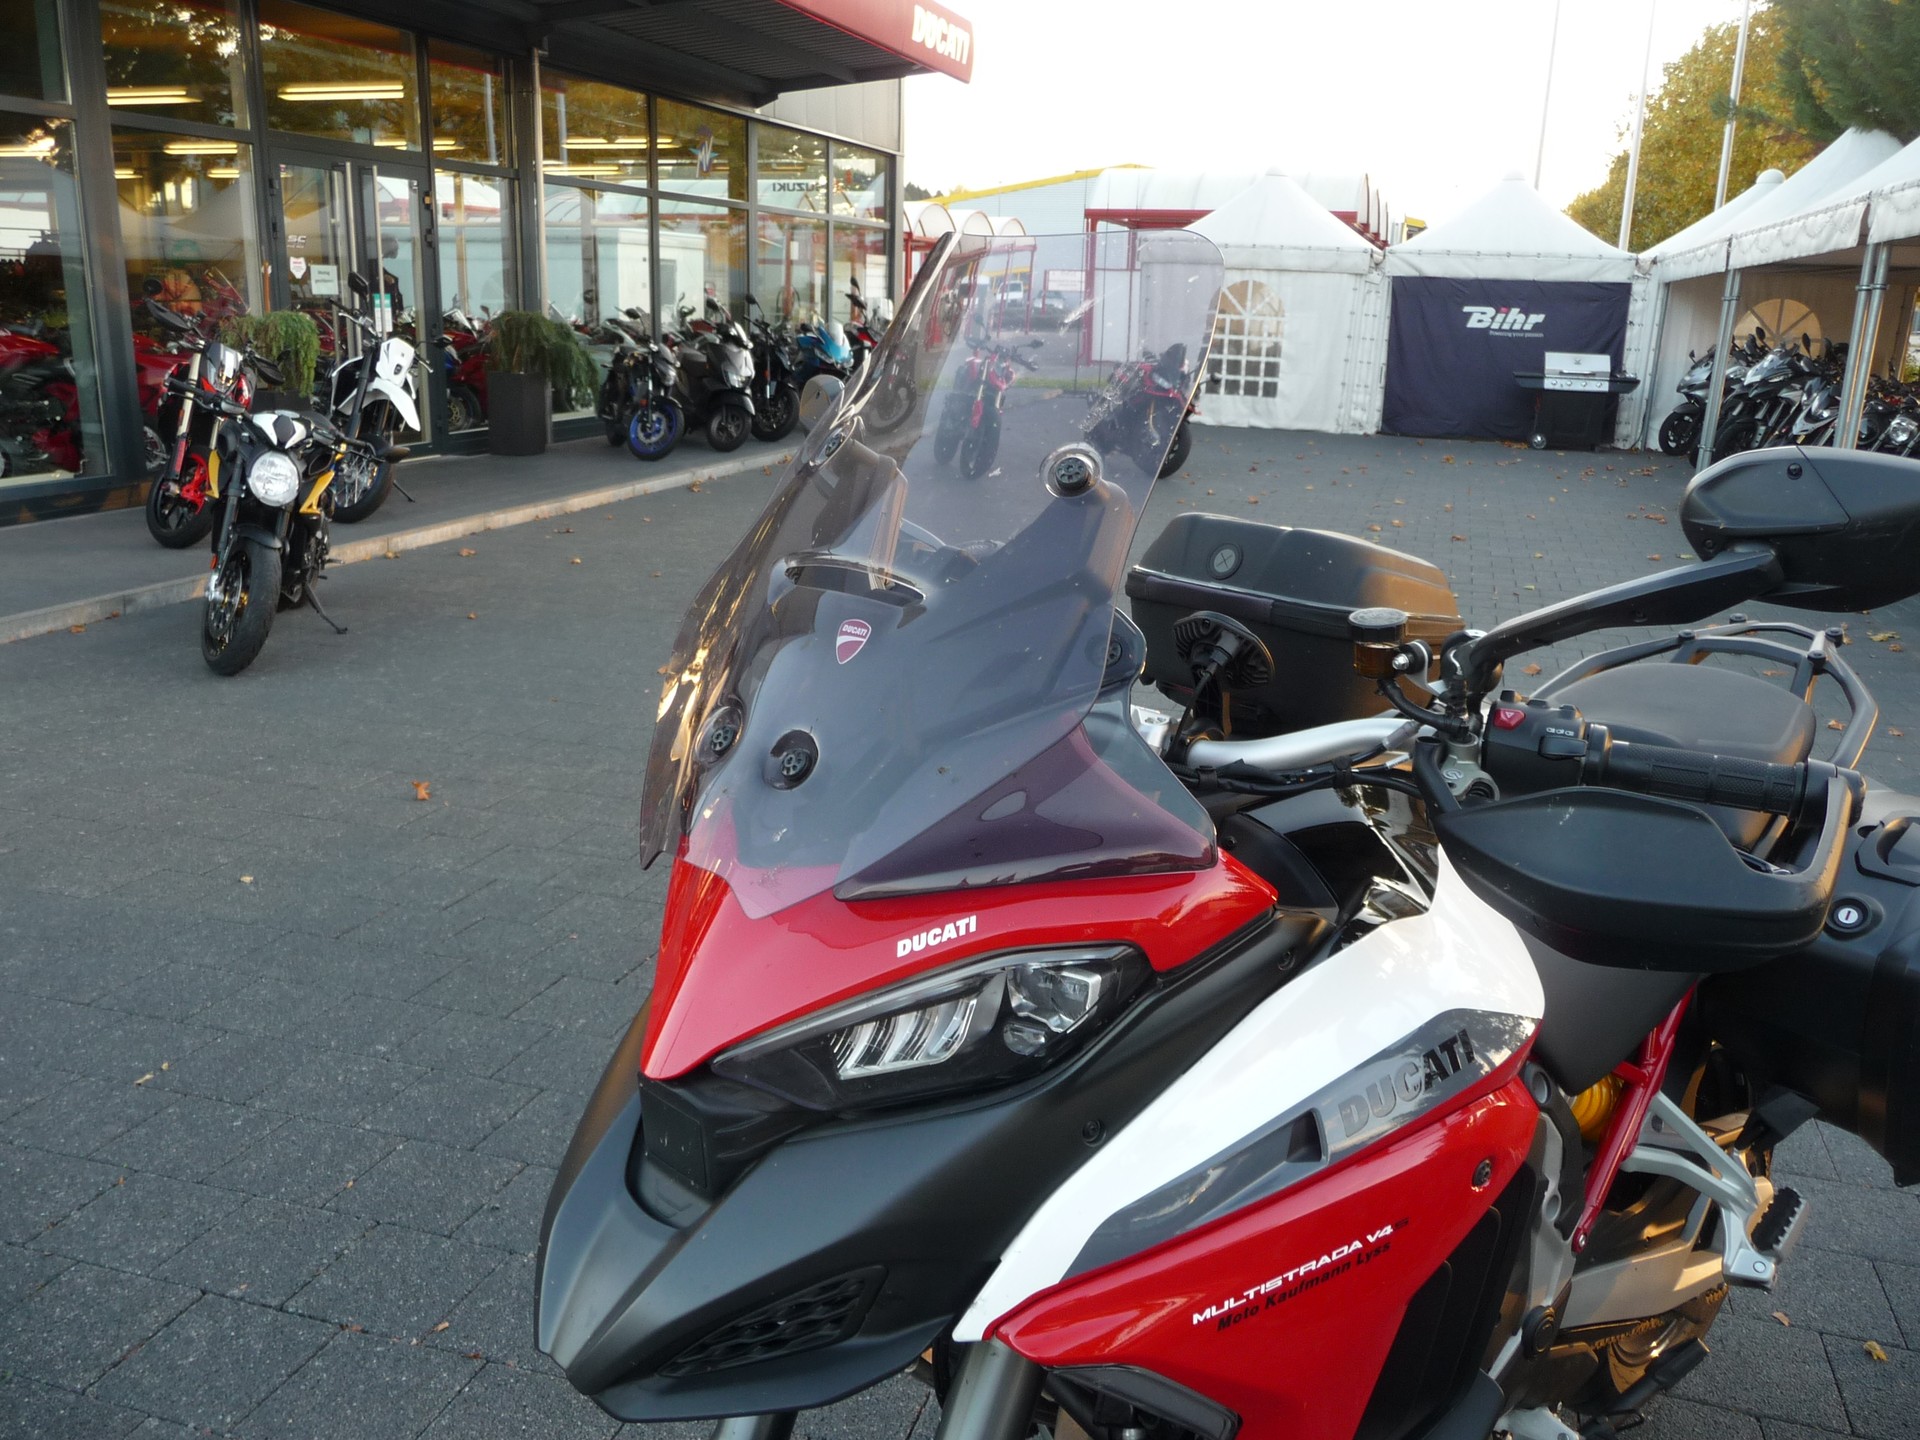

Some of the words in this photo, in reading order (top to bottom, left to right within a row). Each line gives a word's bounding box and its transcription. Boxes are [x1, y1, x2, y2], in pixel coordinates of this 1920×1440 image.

[912, 4, 970, 65] DUCATI
[1462, 306, 1546, 331] Bihr
[842, 624, 868, 637] DUCATI
[896, 914, 977, 958] DUCATI
[1338, 1028, 1476, 1138] DUCATI
[1192, 1239, 1363, 1325] MULTISTRADA
[1216, 1305, 1260, 1332] Moto
[1264, 1261, 1352, 1310] Kaufmann
[1356, 1241, 1391, 1266] Lyss
